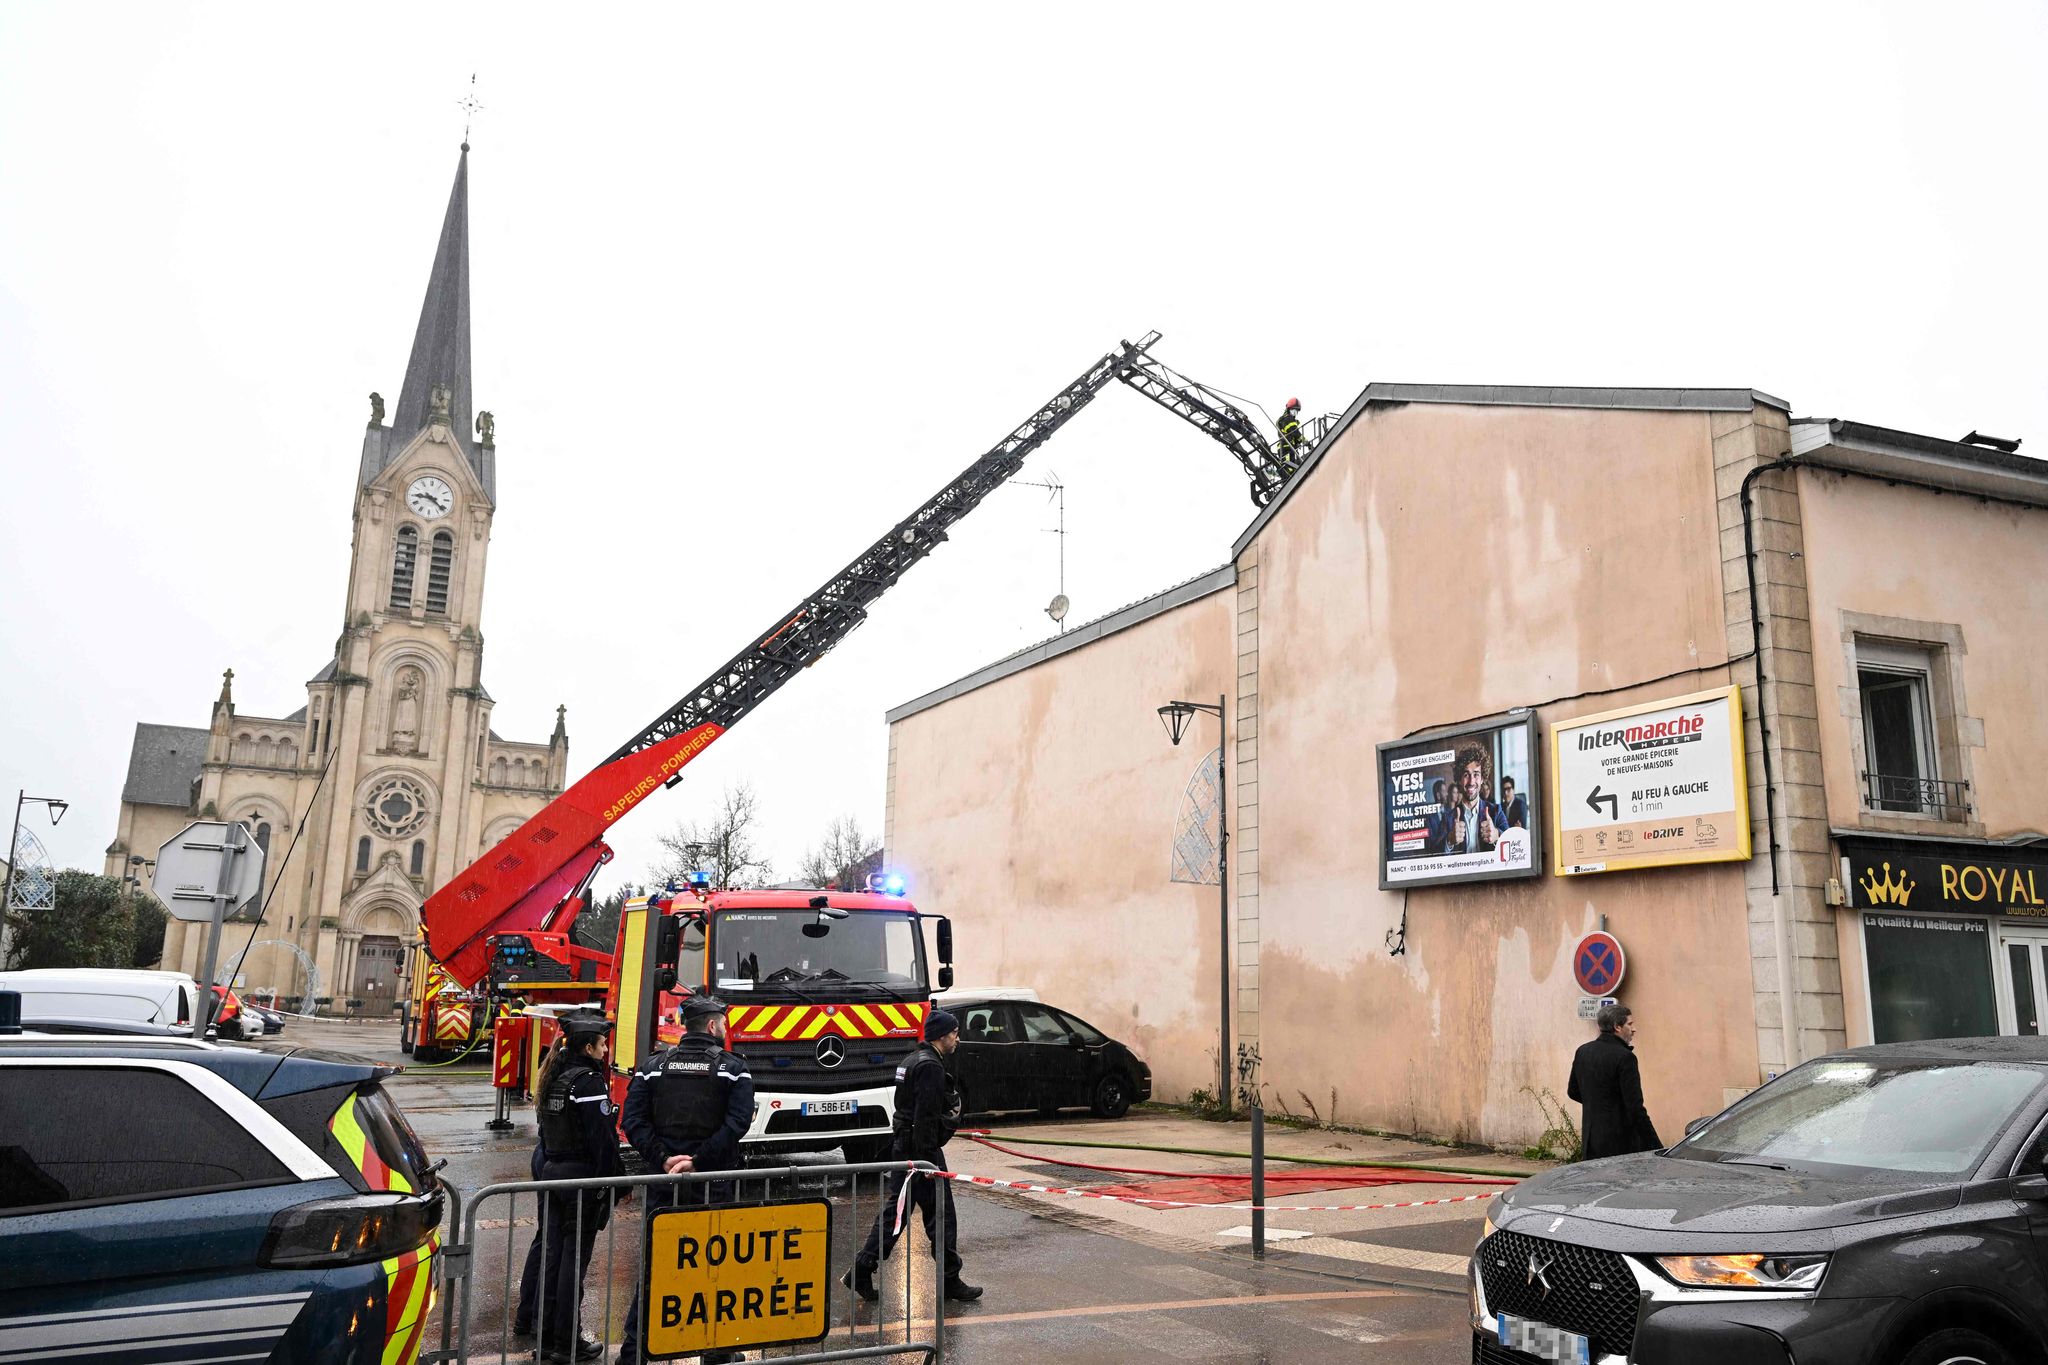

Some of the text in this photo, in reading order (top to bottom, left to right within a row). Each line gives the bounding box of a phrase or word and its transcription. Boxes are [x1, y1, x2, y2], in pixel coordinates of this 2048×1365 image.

[1579, 714, 1704, 751] Intermarché
[1641, 736, 1690, 748] HYPER
[1429, 753, 1452, 762] ENGLISH?
[1601, 748, 1679, 766] VOTRE GRANDE ÉPICERIE
[604, 776, 656, 820] SAPEURS
[661, 727, 716, 774] POMPIERS
[1617, 759, 1673, 774] NEUVES-MAISONS
[1392, 772, 1424, 792] YES!
[1392, 791, 1426, 806] I SPEAK
[1632, 782, 1709, 801] AU FEU À GAUCHE
[1392, 803, 1441, 818] WALL STREET
[1632, 801, 1663, 813] à 1 min
[1393, 818, 1425, 831] ENGLISH
[1644, 827, 1684, 840] leDRIVE
[1448, 859, 1494, 868] wallstreetenglish.fr
[1941, 864, 2045, 904] ROYAL
[1865, 917, 1984, 932] La Qualité Au Meilleur Prix
[668, 1062, 710, 1071] GENDARMERIE
[808, 1102, 850, 1113] FL-586-EA
[678, 1228, 802, 1269] ROUTE
[662, 1277, 813, 1328] BARRÉE
